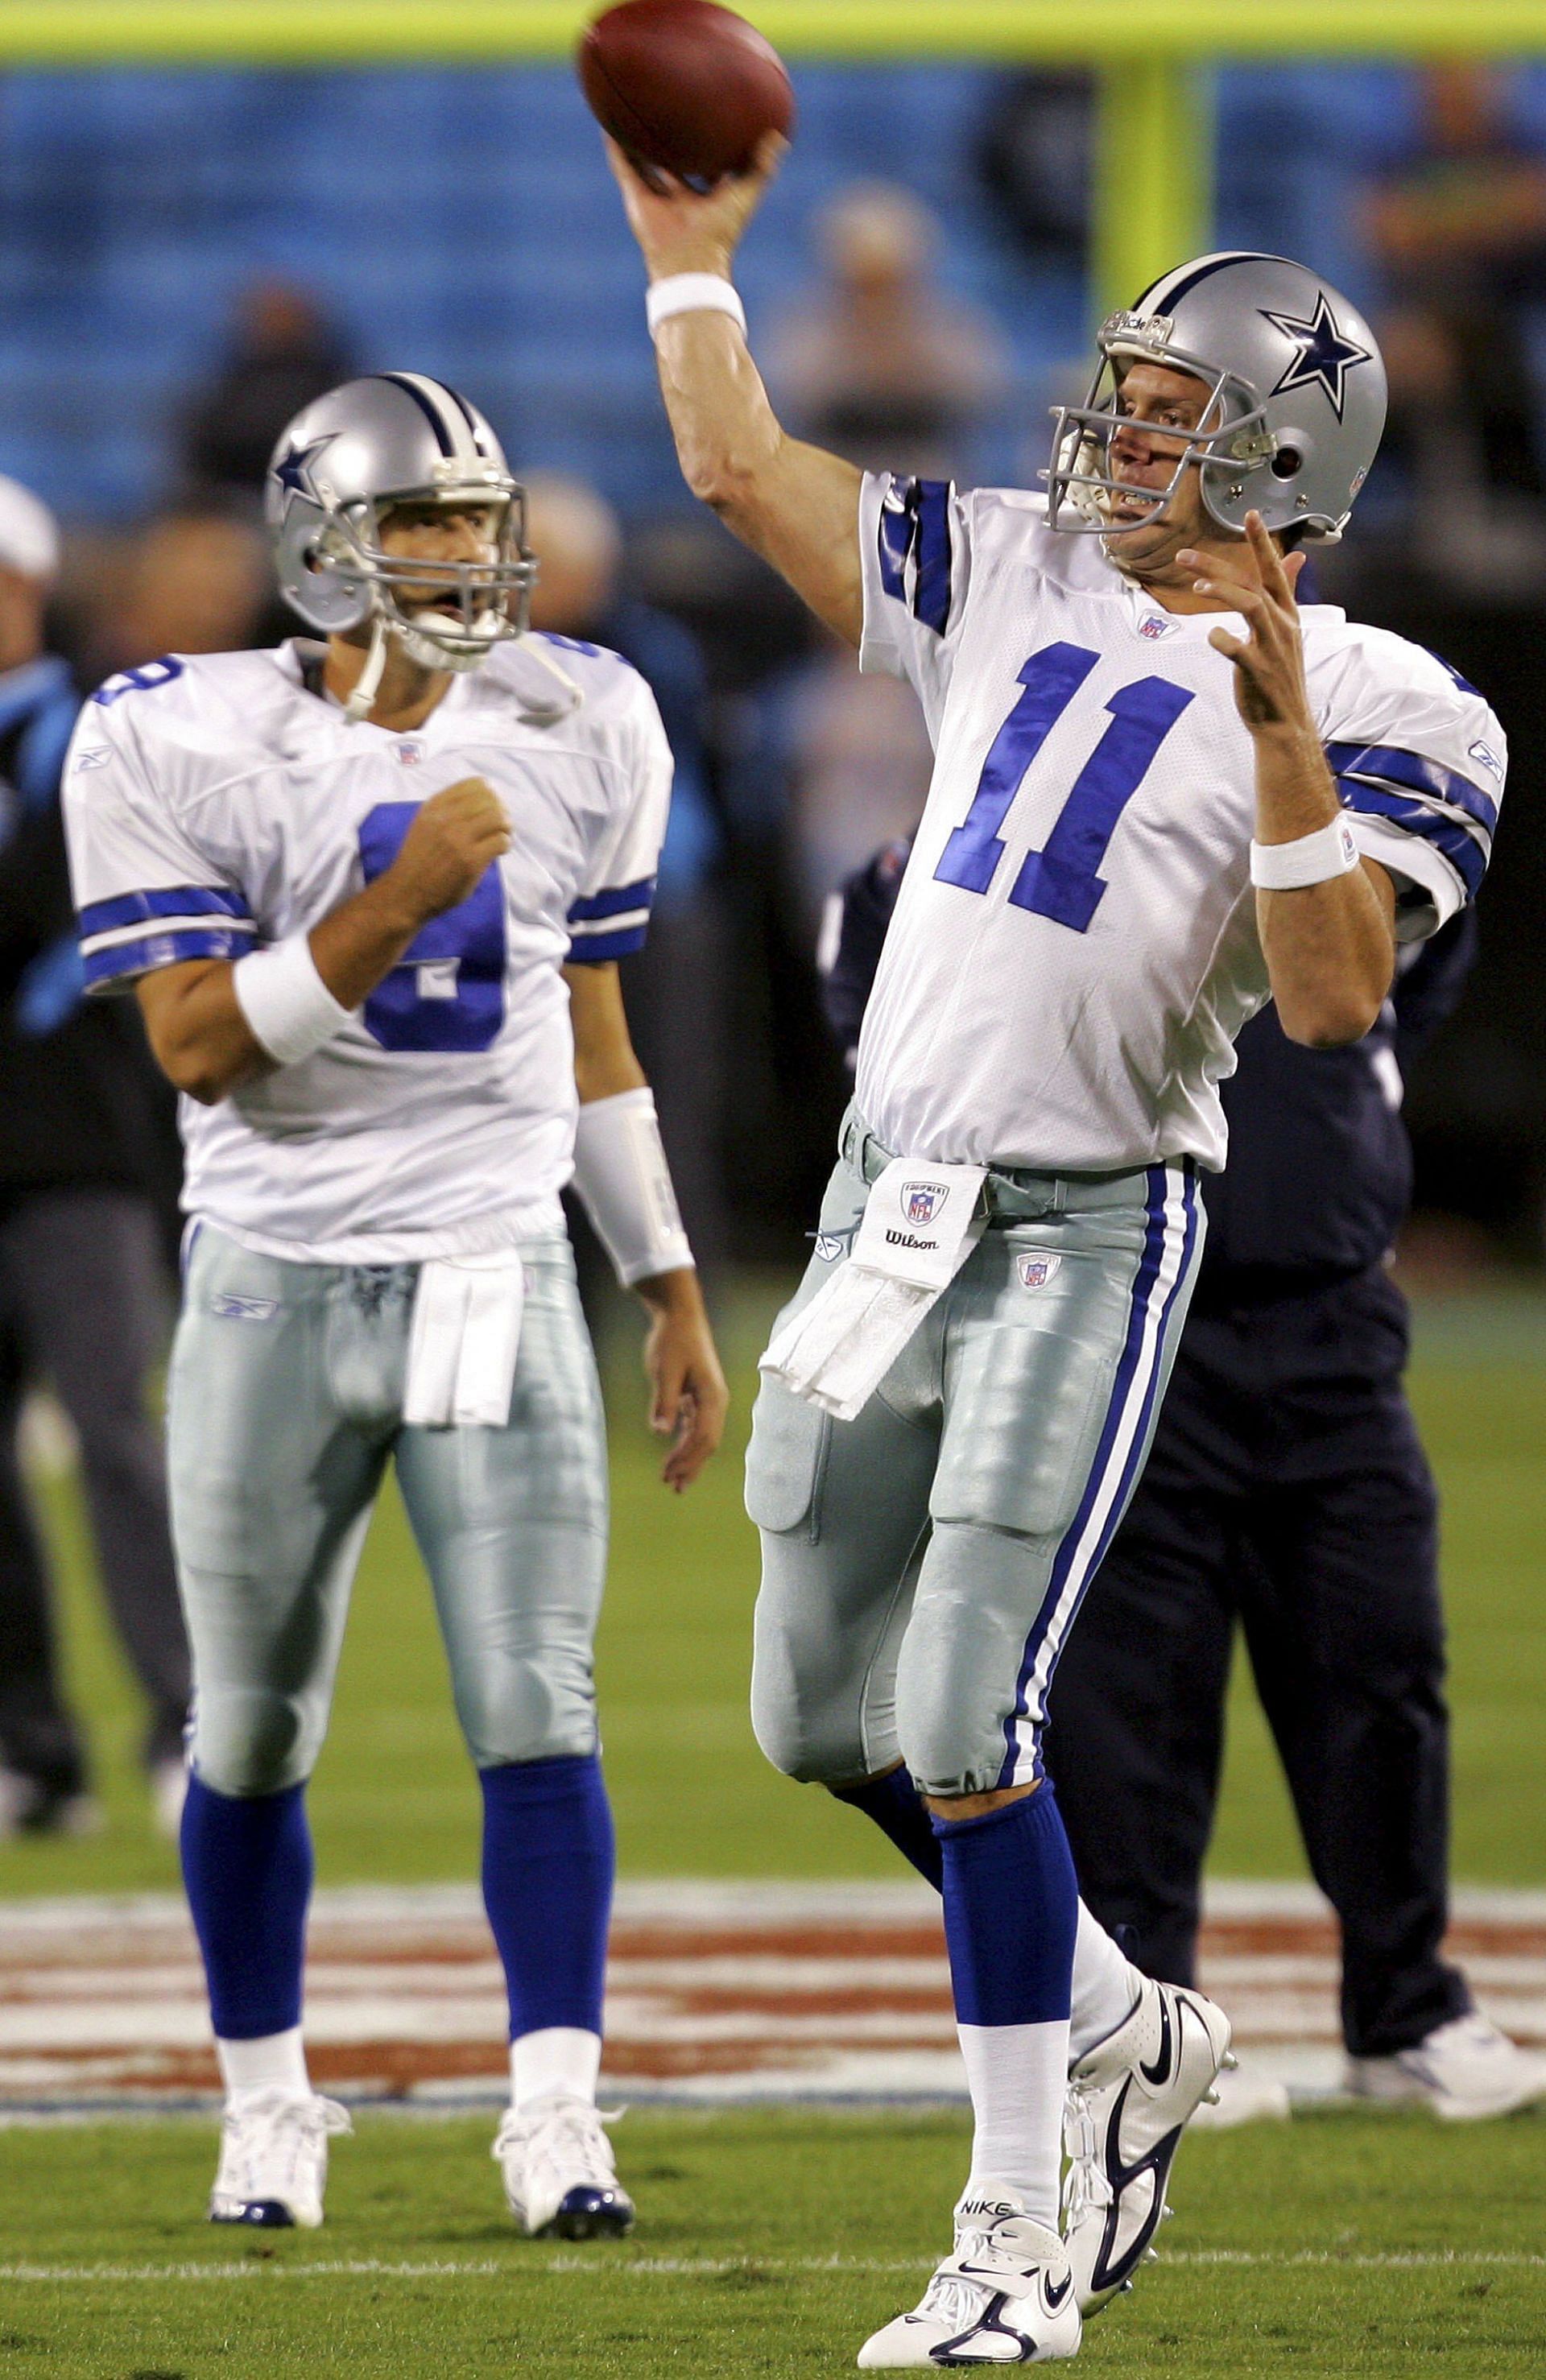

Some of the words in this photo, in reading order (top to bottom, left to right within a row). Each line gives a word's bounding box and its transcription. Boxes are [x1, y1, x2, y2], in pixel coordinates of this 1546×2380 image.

[932, 641, 1197, 934] 11
[358, 800, 507, 1052] 9
[908, 1203, 932, 1221] NFL
[886, 1229, 940, 1250] Wilson
[961, 2200, 1011, 2216] NIKE
